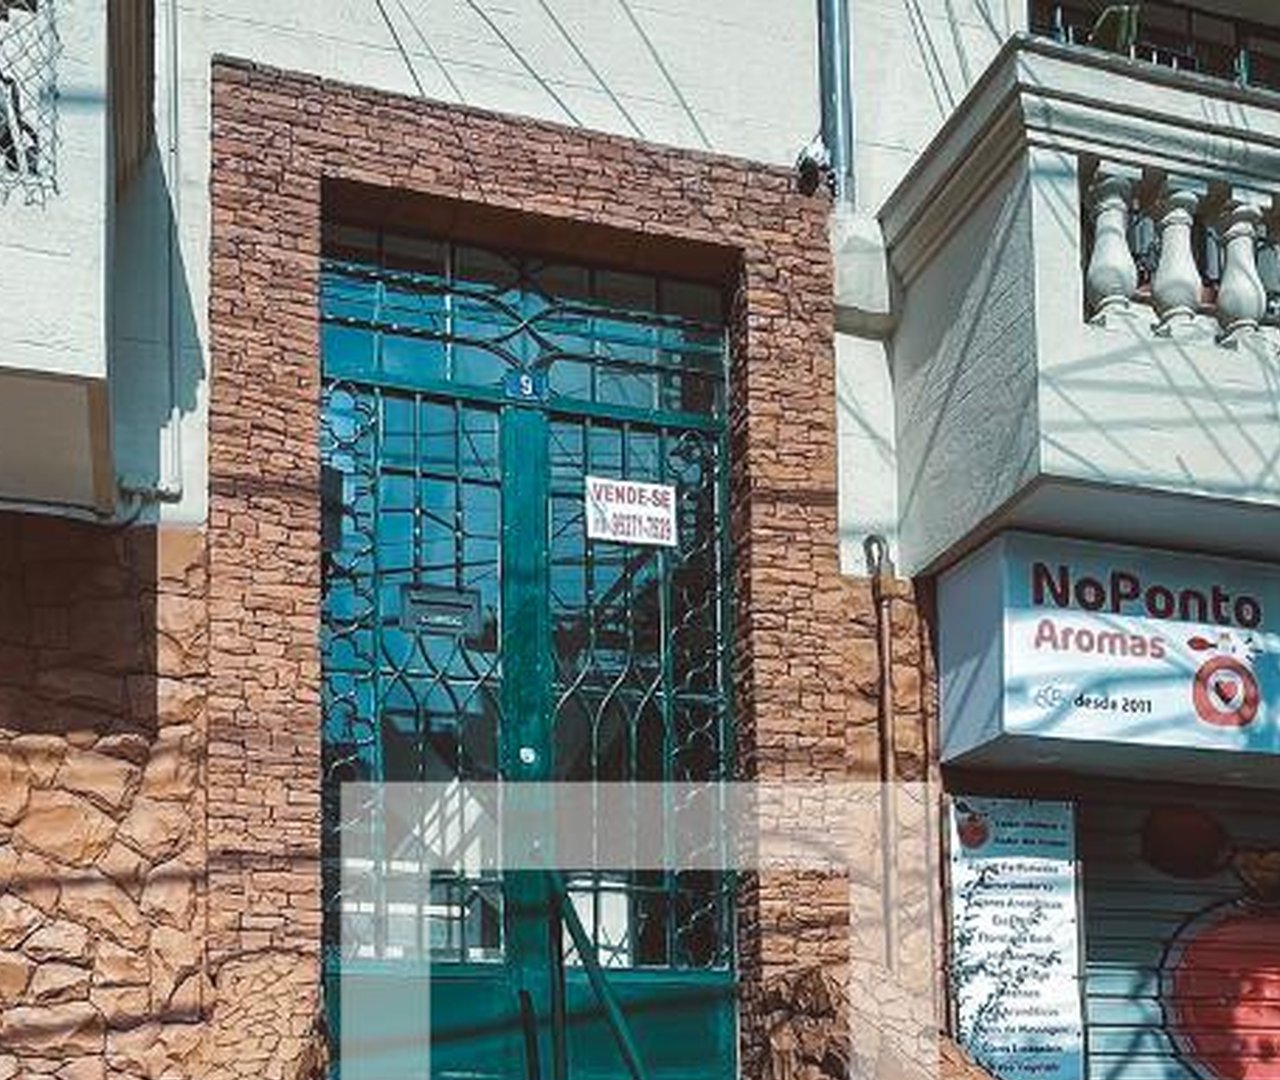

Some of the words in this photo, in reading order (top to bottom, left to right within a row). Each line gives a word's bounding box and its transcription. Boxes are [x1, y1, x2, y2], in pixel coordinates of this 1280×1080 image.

[592, 482, 671, 508] VENDE-SE
[1032, 561, 1262, 629] NoPonto
[1034, 618, 1167, 660] Aromas
[1073, 692, 1117, 711] desde
[1122, 697, 1153, 714] 2011
